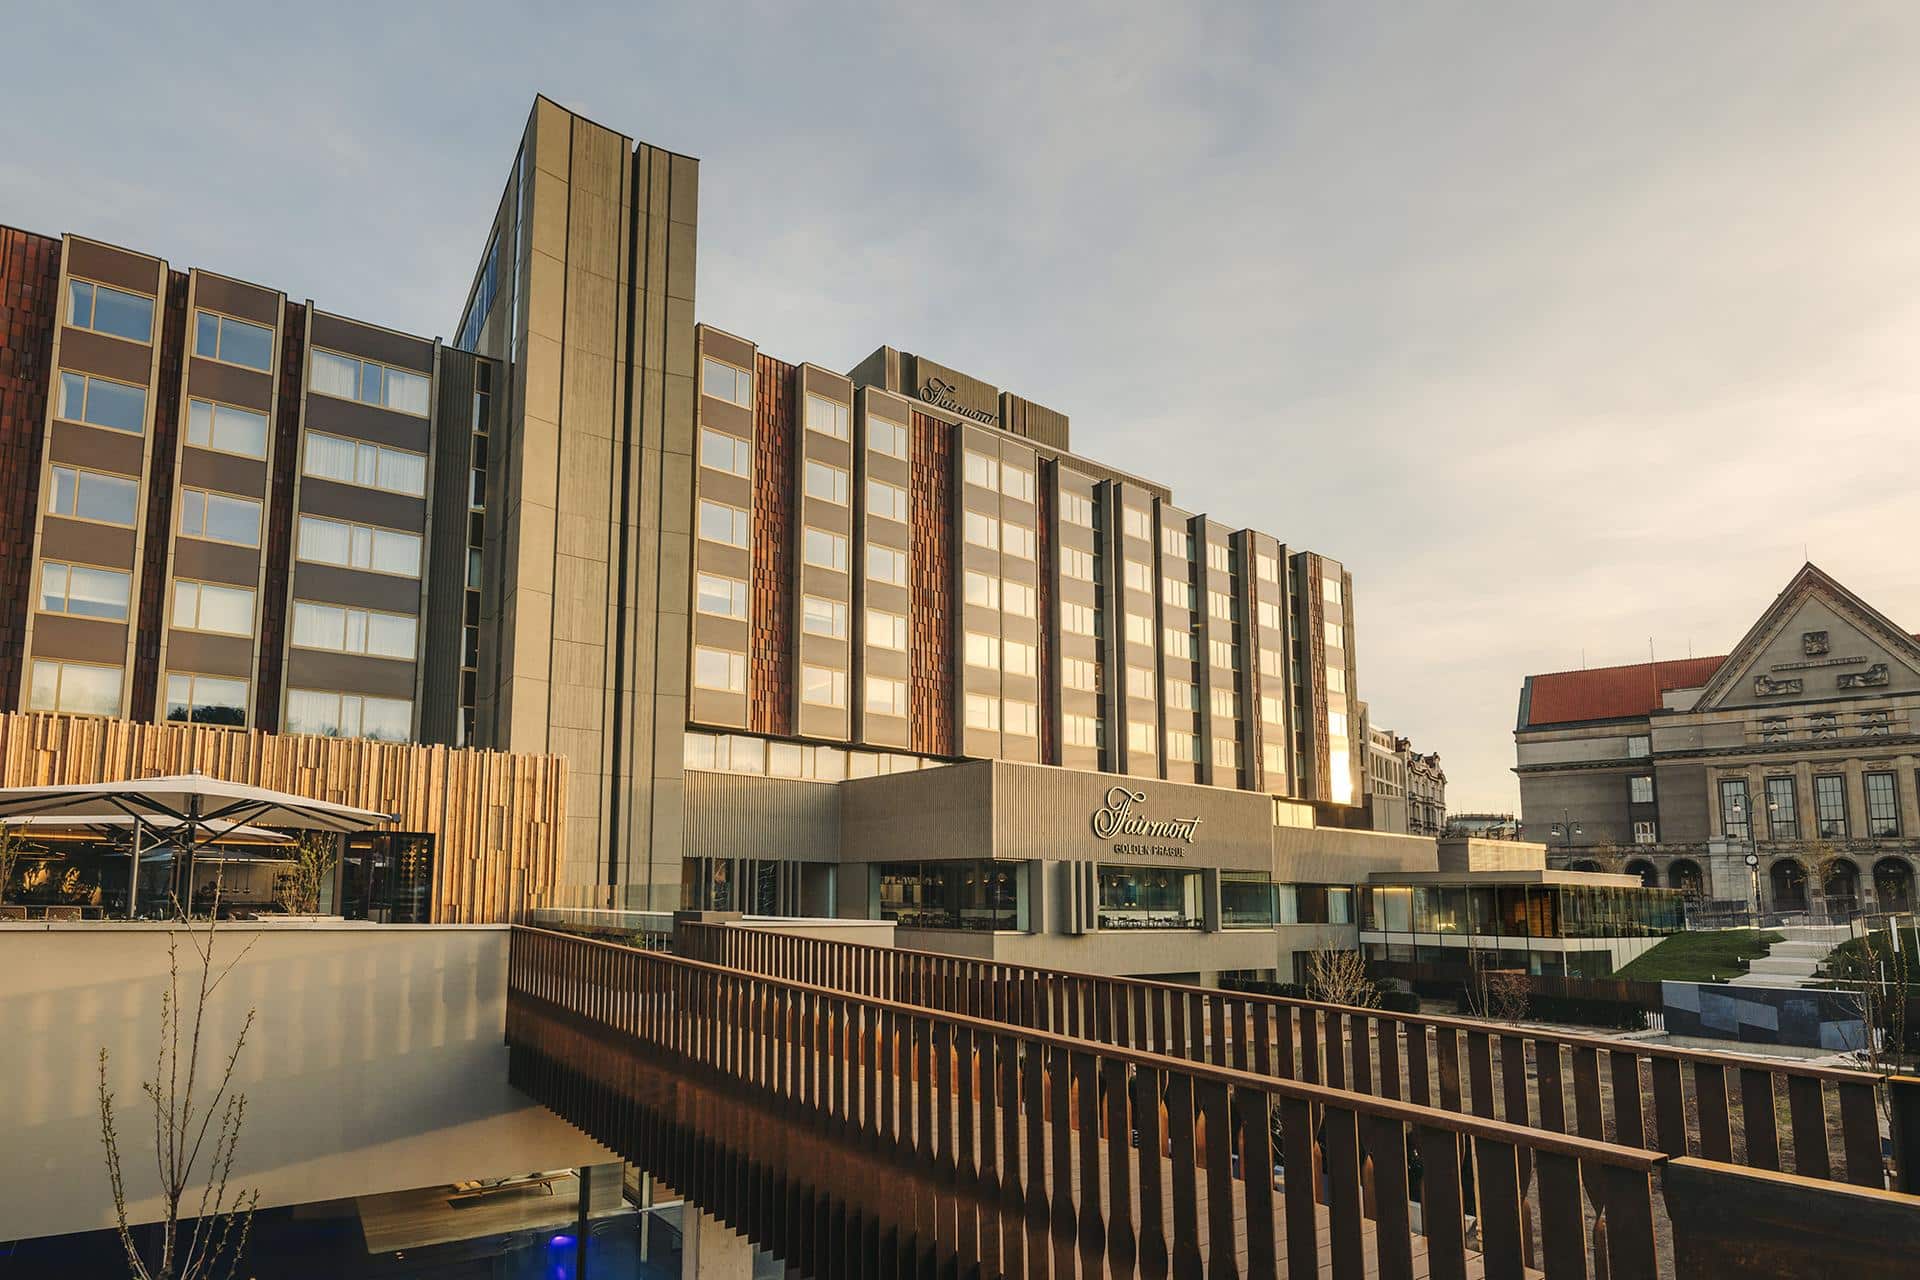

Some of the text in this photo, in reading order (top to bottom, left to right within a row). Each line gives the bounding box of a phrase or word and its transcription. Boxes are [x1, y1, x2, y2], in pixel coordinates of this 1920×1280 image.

[919, 376, 999, 424] Fairmont
[1094, 786, 1203, 843] Fairmont
[1113, 843, 1185, 857] GOLDEN PRAGUE
